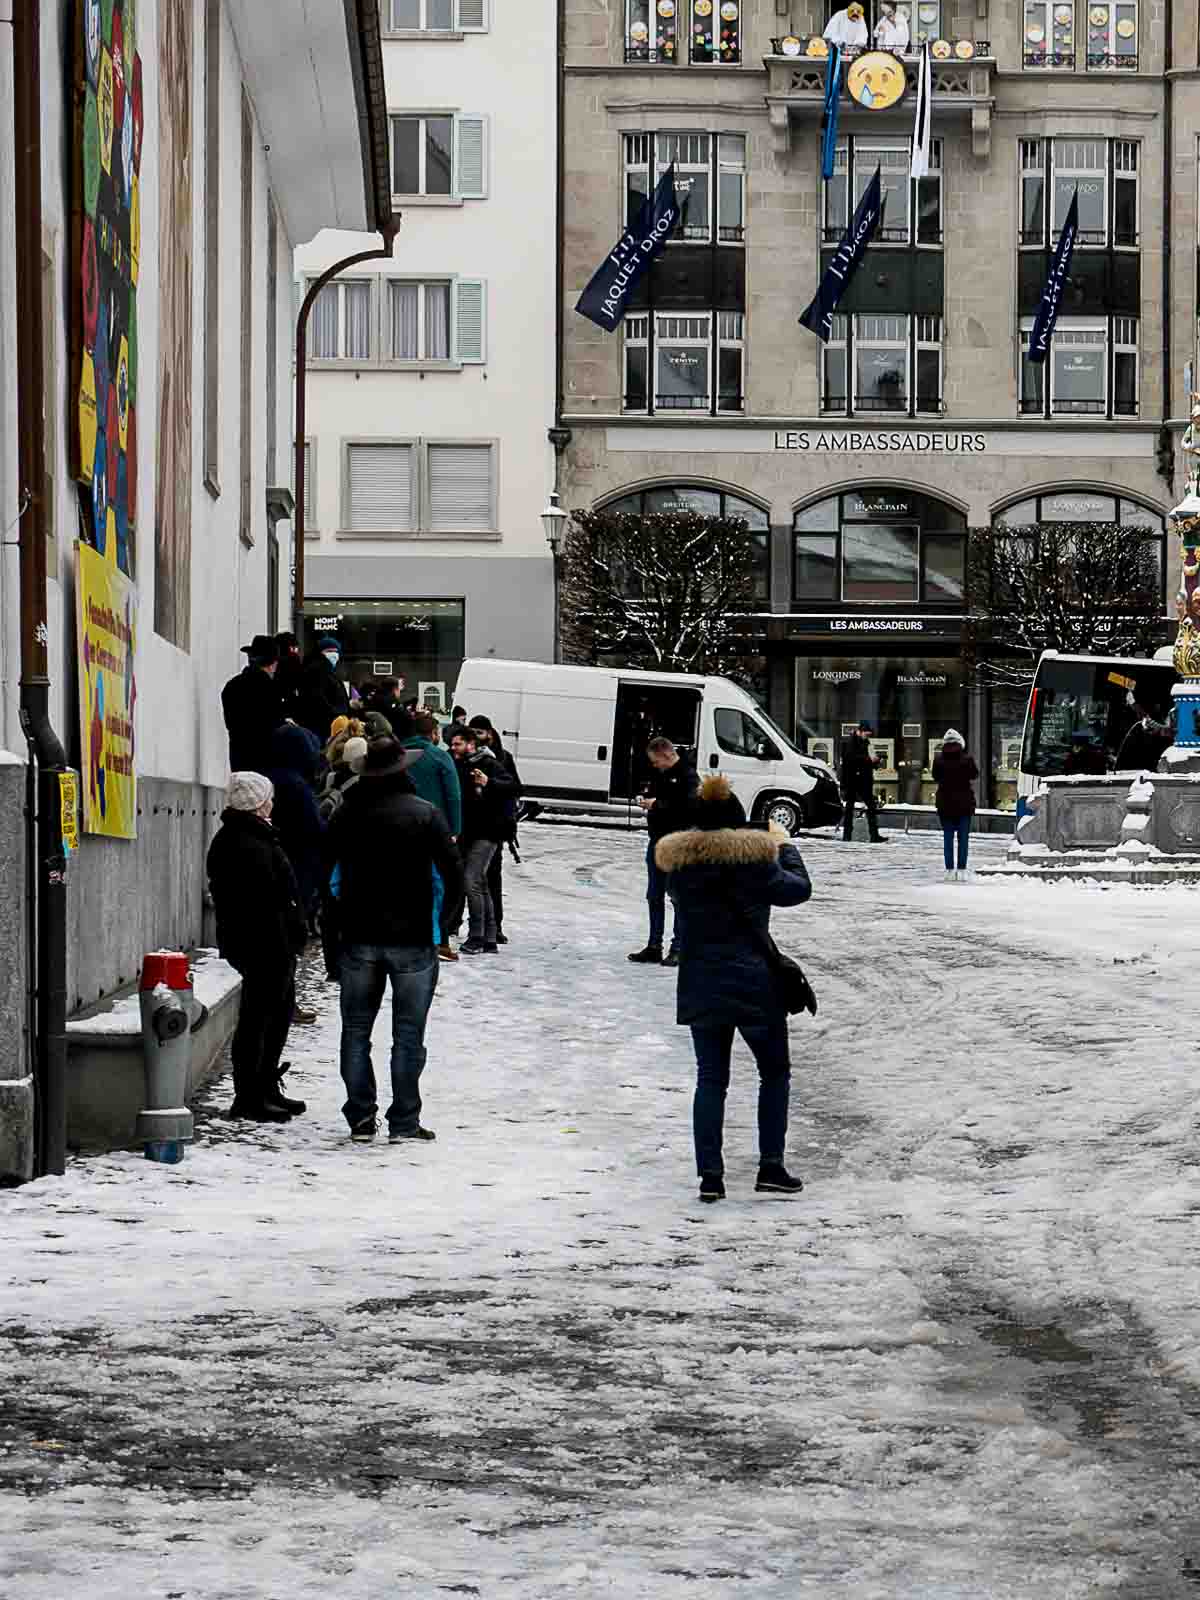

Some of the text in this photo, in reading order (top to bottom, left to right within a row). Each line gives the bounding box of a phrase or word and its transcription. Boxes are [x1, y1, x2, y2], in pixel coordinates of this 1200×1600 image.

[600, 207, 675, 320] JAQUET DROZ
[773, 431, 986, 451] LES AMBASSADEURS
[830, 620, 923, 631] LES AMBASSADEURS
[813, 671, 861, 680] LONGINES
